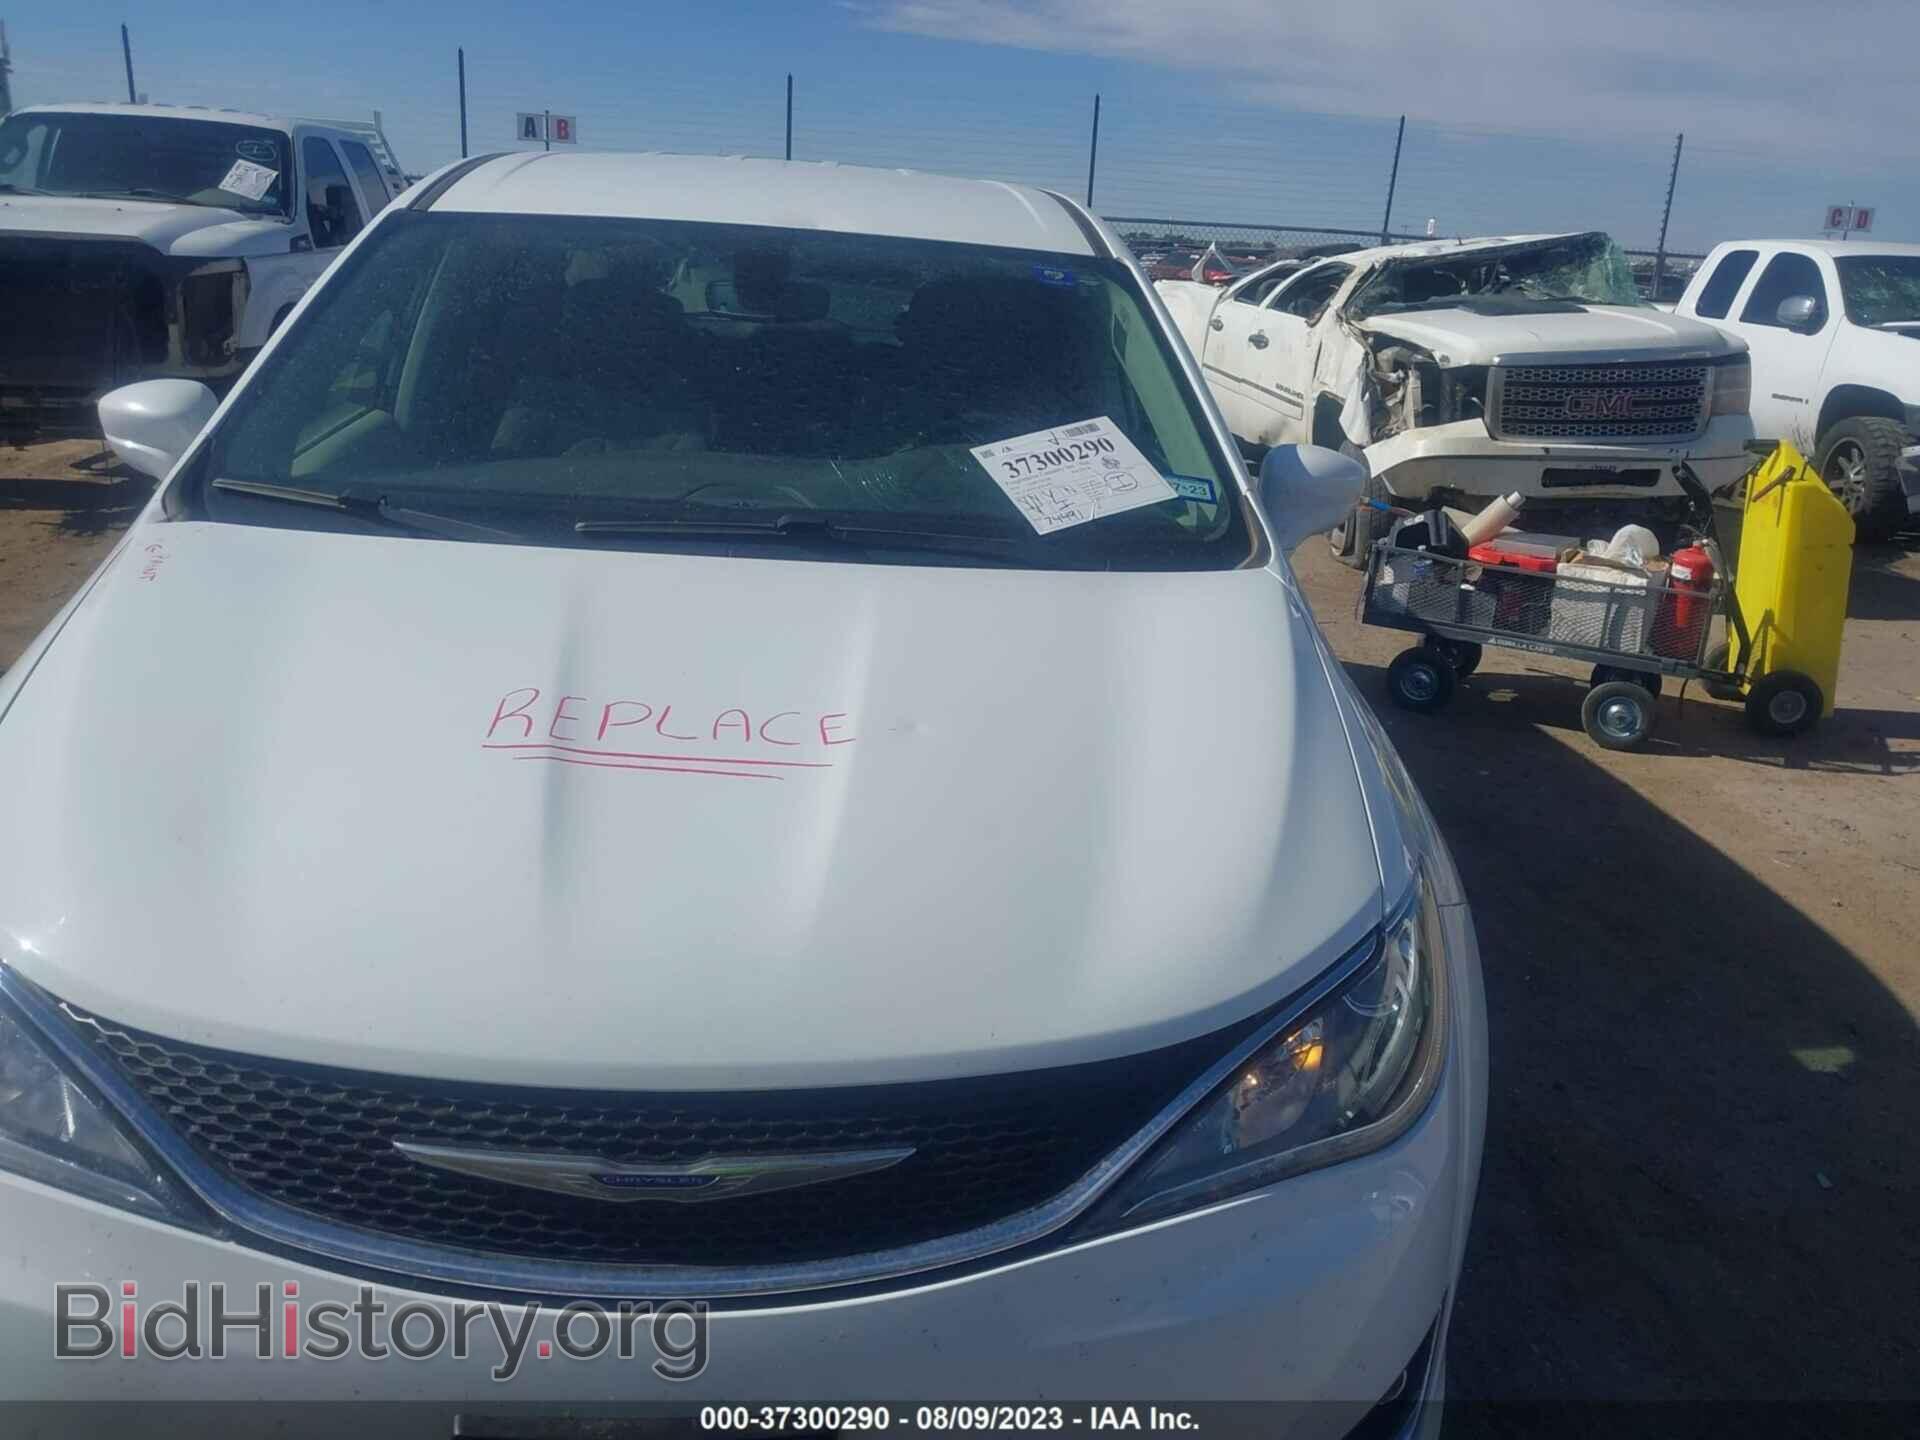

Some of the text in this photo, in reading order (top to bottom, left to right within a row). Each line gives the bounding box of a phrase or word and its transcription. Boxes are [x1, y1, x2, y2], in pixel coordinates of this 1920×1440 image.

[524, 117, 570, 139] A B
[1831, 208, 1869, 229] C D
[1566, 392, 1651, 417] GMC
[1002, 437, 1115, 479] 37300290
[487, 687, 856, 746] REPLACE
[602, 1175, 706, 1186] CHRYSLER
